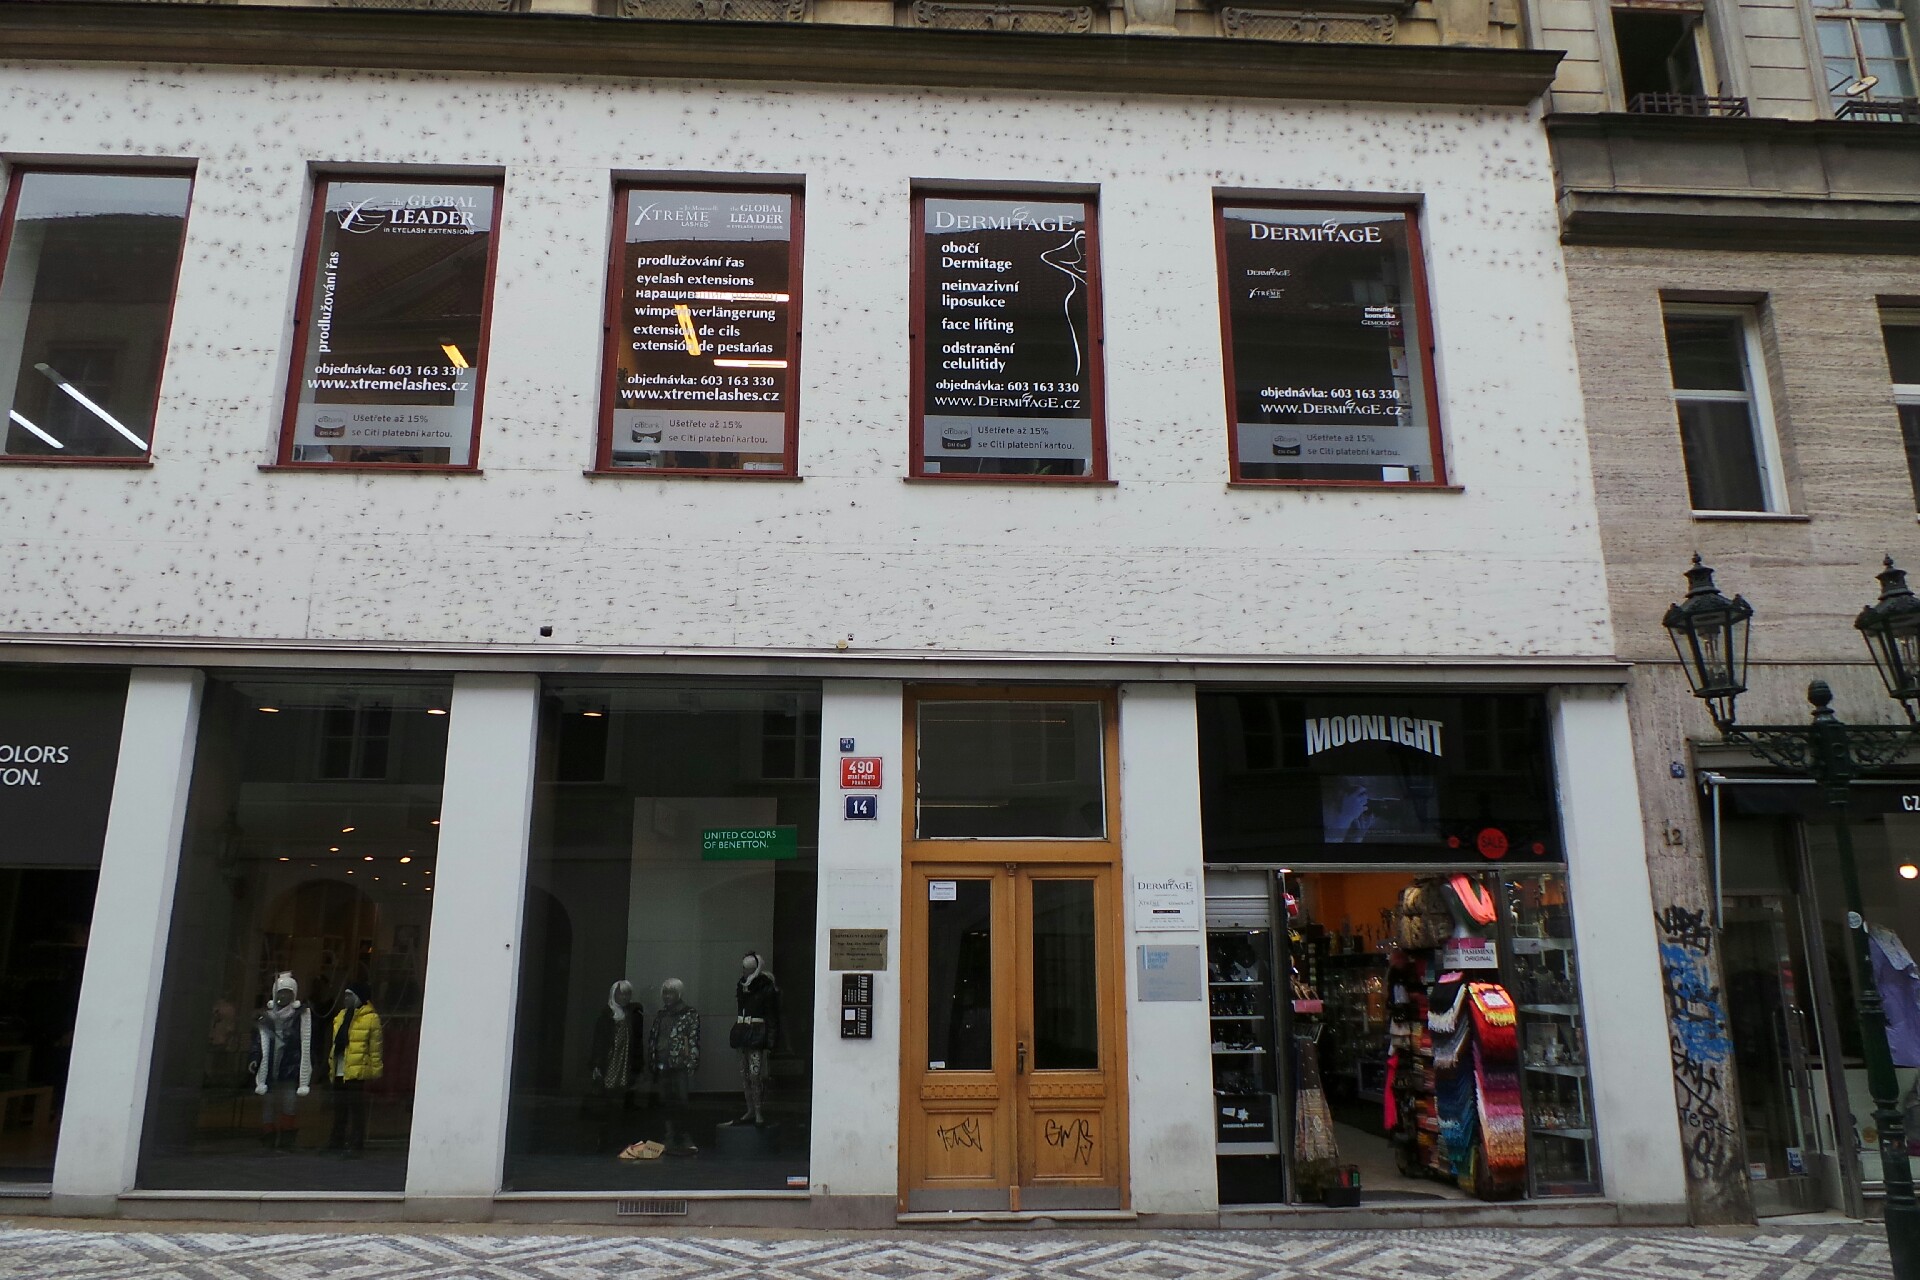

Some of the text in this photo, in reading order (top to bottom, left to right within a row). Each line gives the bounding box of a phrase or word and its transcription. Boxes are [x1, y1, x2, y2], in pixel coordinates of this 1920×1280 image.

[408, 195, 477, 208] GLOBAL
[740, 204, 784, 213] GLOBAL
[390, 209, 475, 226] LEADER
[730, 213, 783, 224] LEADER
[935, 210, 1075, 232] DERMITAGE
[1250, 222, 1382, 243] DERMITAGE
[941, 241, 980, 255] obočí
[637, 254, 745, 268] prodlužování řas
[942, 257, 1012, 272] Dermitage
[636, 272, 754, 286] eyelash extensions
[942, 280, 1020, 293] neinvazivní
[317, 251, 340, 353] prodlužování řas
[942, 294, 1006, 309] liposukce
[633, 324, 740, 336] extension de cils
[942, 318, 1014, 334] face lifting
[699, 340, 714, 351] de
[942, 342, 1015, 354] odstranění
[314, 363, 464, 376] objednávka: 603 163 330
[942, 358, 1006, 373] celulitidy
[307, 377, 469, 391] www.xtremelashes.cz
[627, 374, 774, 386] objednávka: 603 163 330
[936, 379, 1080, 393] objednávka: 603 163 330
[621, 388, 780, 401] www.xtremelashes.cz
[1261, 387, 1399, 399] objednávka: 603 163 330
[353, 414, 429, 423] Ušetřete až 15%
[670, 419, 743, 429] Ušetřete až 15%
[382, 429, 419, 438] platební
[421, 430, 453, 438] kartou.
[978, 426, 1014, 434] Ušetřete
[1030, 427, 1049, 435] 15%
[681, 434, 696, 442] Citi
[698, 434, 735, 444] platební
[736, 436, 768, 444] kartou.
[990, 440, 1005, 448] Citi
[1008, 440, 1042, 450] platební
[1045, 441, 1075, 450] kartou.
[1336, 448, 1369, 456] platební
[1305, 715, 1443, 757] MOONLIGHT
[848, 761, 874, 774] 490
[854, 800, 867, 814] 14
[704, 830, 777, 840] UNITED COLORS
[1663, 828, 1683, 846] 12
[703, 840, 769, 849] OF BENETTON.
[1138, 881, 1193, 890] DERMITAGE
